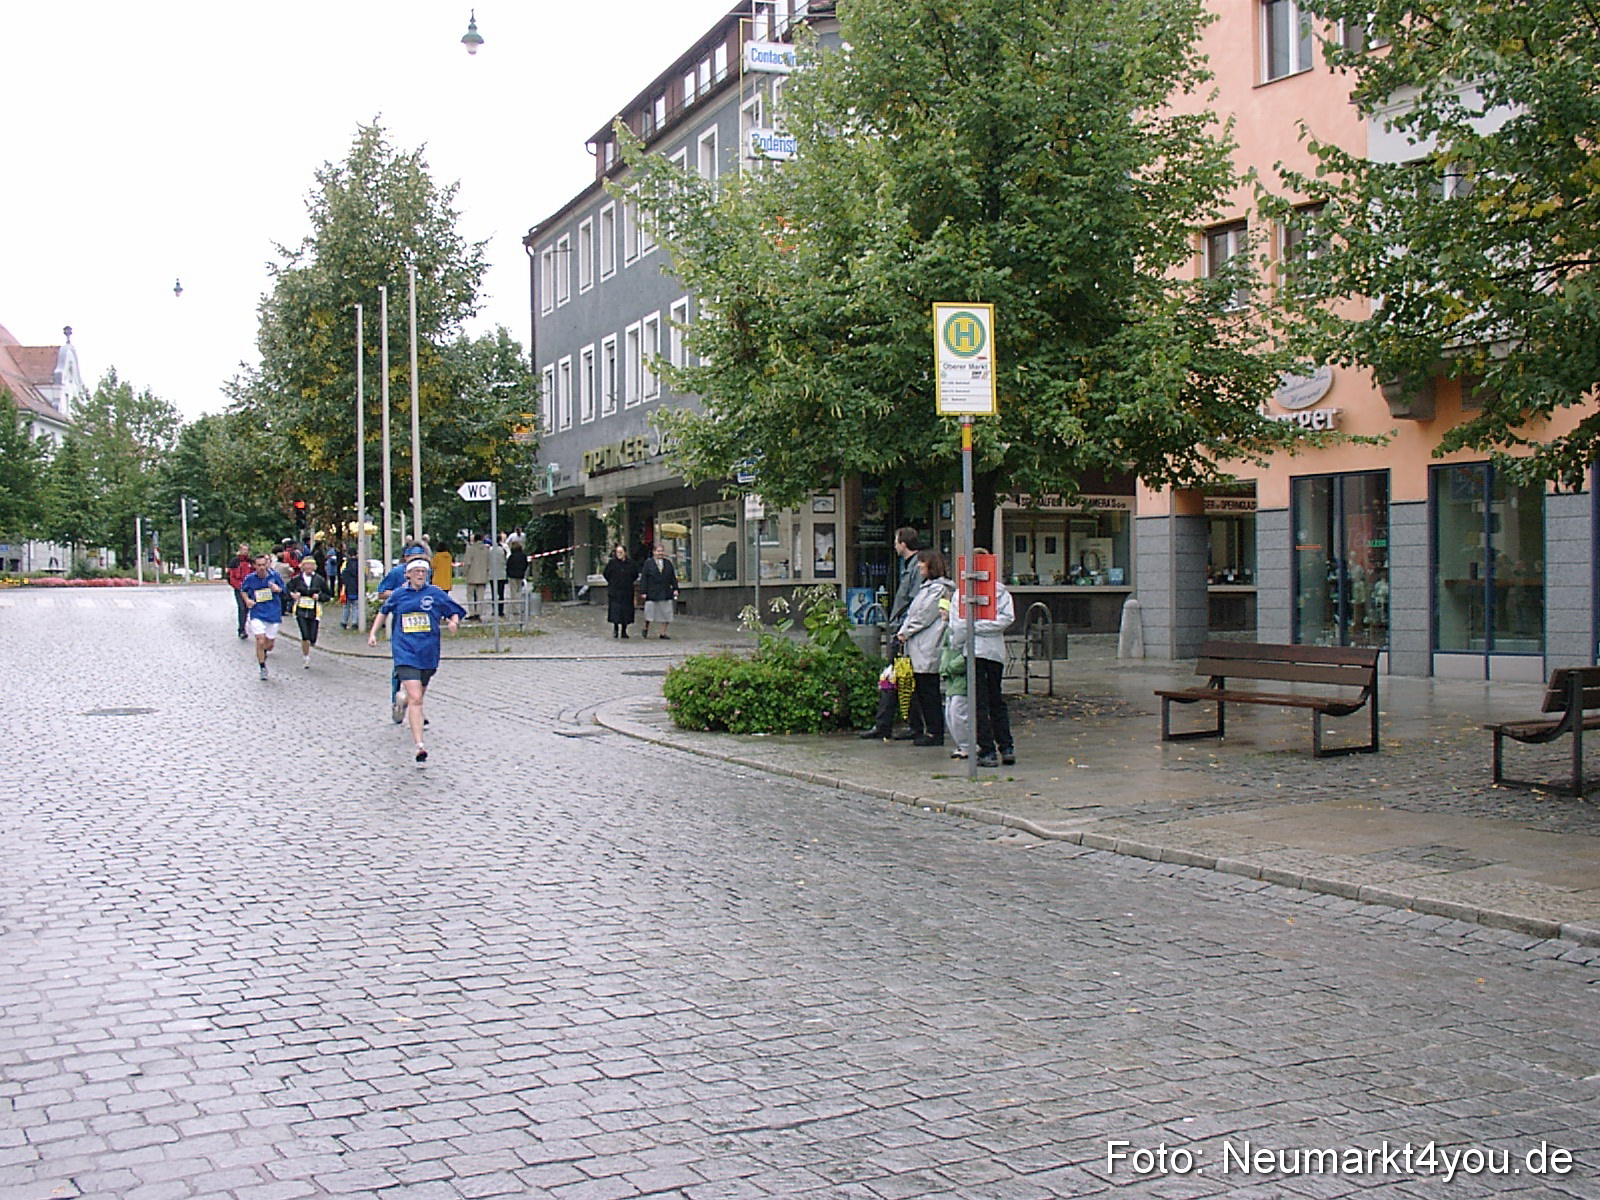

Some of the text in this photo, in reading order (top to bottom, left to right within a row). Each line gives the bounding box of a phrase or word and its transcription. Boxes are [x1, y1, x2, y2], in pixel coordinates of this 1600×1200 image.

[955, 322, 975, 347] H
[582, 435, 648, 474] OPTIKER
[467, 484, 487, 498] WC
[408, 616, 428, 626] 1373
